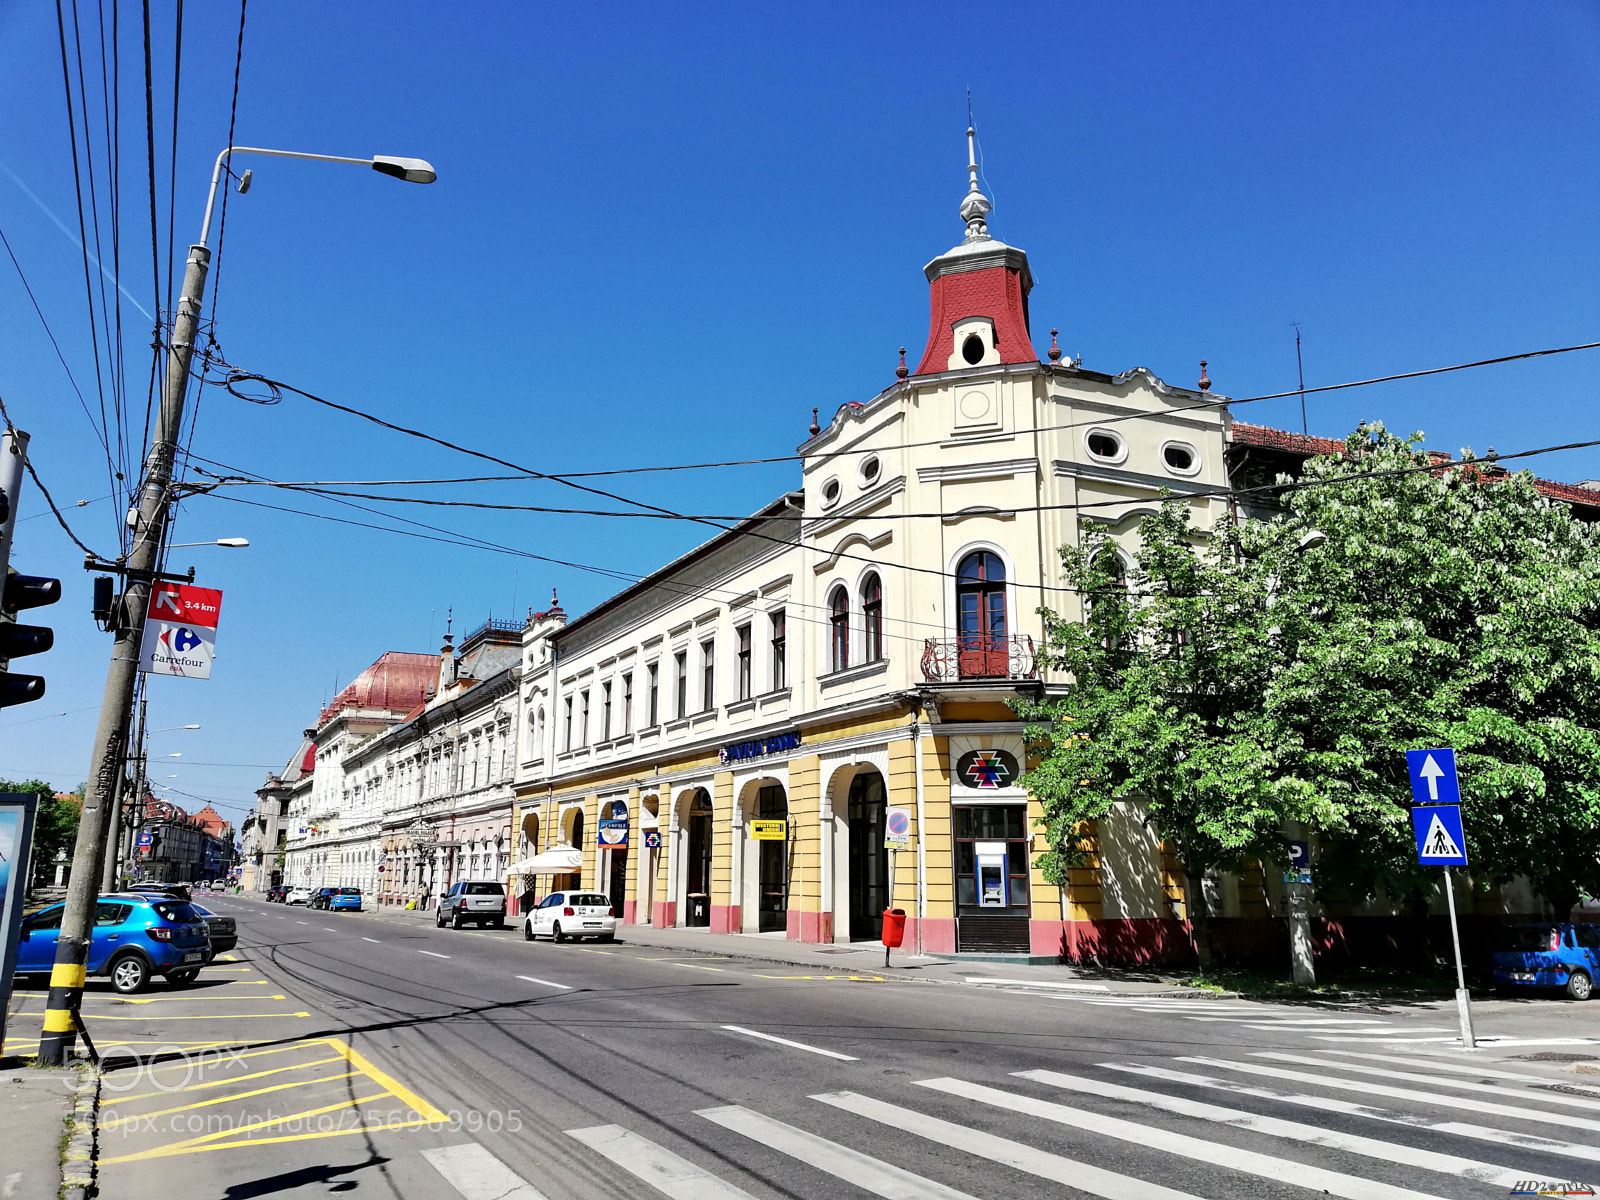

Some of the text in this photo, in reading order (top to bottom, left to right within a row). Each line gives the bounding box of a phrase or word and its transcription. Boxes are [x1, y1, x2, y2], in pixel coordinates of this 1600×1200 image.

[184, 601, 216, 612] 3.4 km
[151, 653, 204, 667] Carrefour
[726, 733, 798, 760] PATRIA BANK
